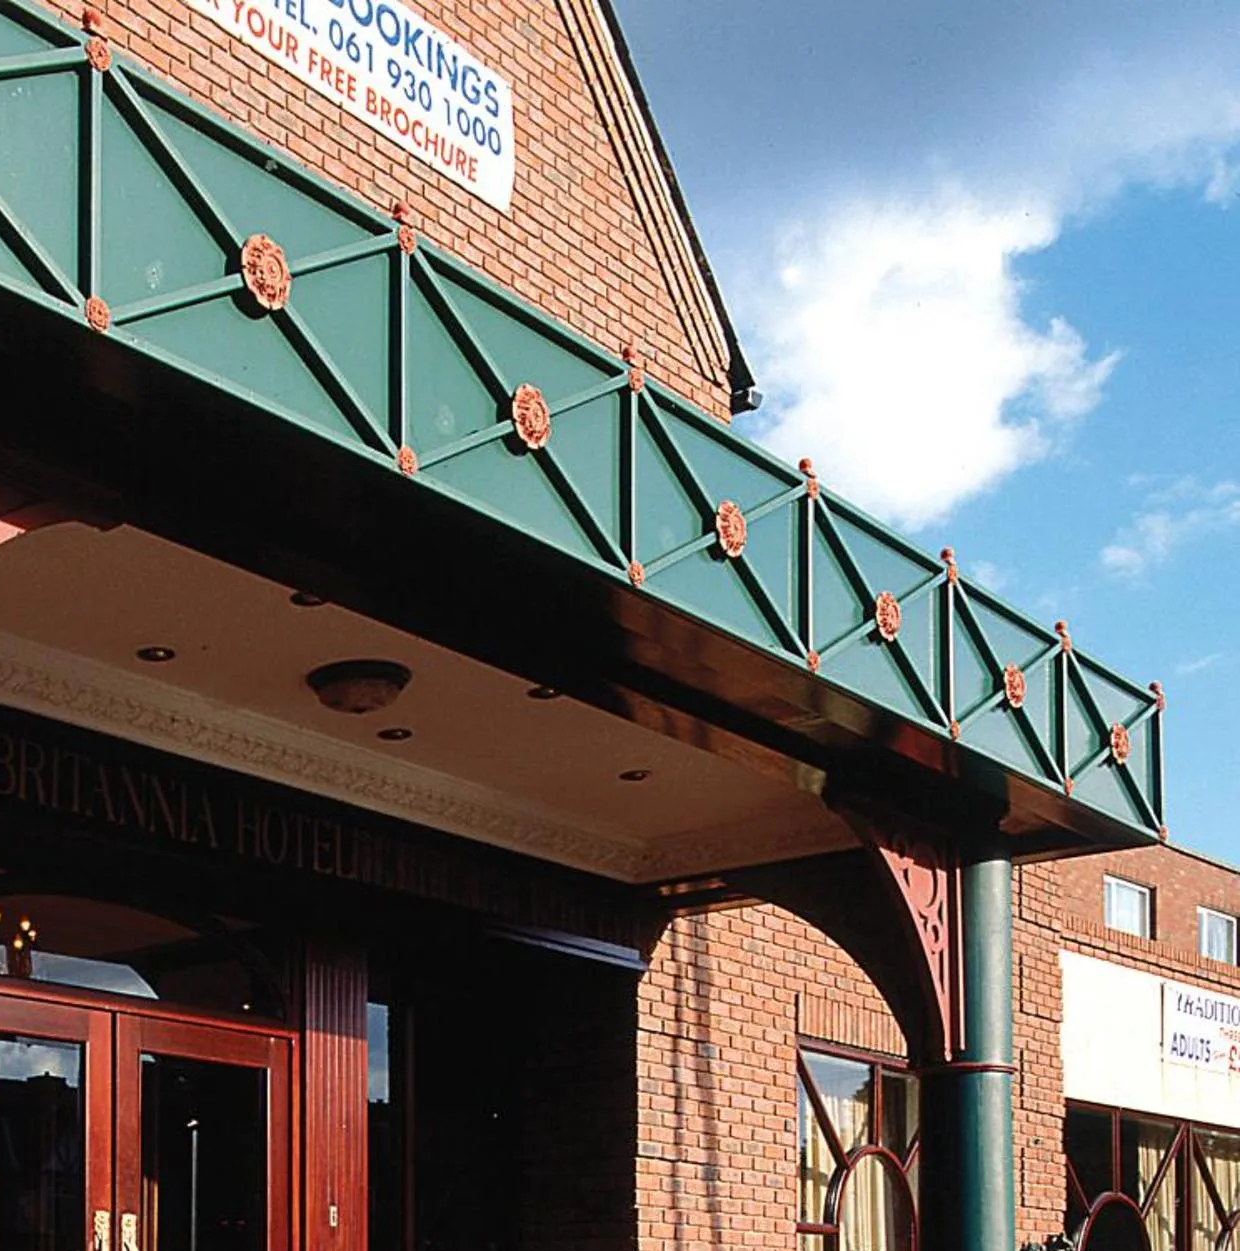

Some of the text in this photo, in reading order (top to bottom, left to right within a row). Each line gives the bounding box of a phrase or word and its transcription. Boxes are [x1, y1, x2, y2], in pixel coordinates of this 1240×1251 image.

[232, 0, 479, 183] YOUR FREE BROCHURE
[273, 0, 502, 156] EL. 061 930 1000
[328, 0, 499, 118] OOKINGS
[235, 800, 358, 880] HOTEL
[1170, 1031, 1211, 1063] ADULTS
